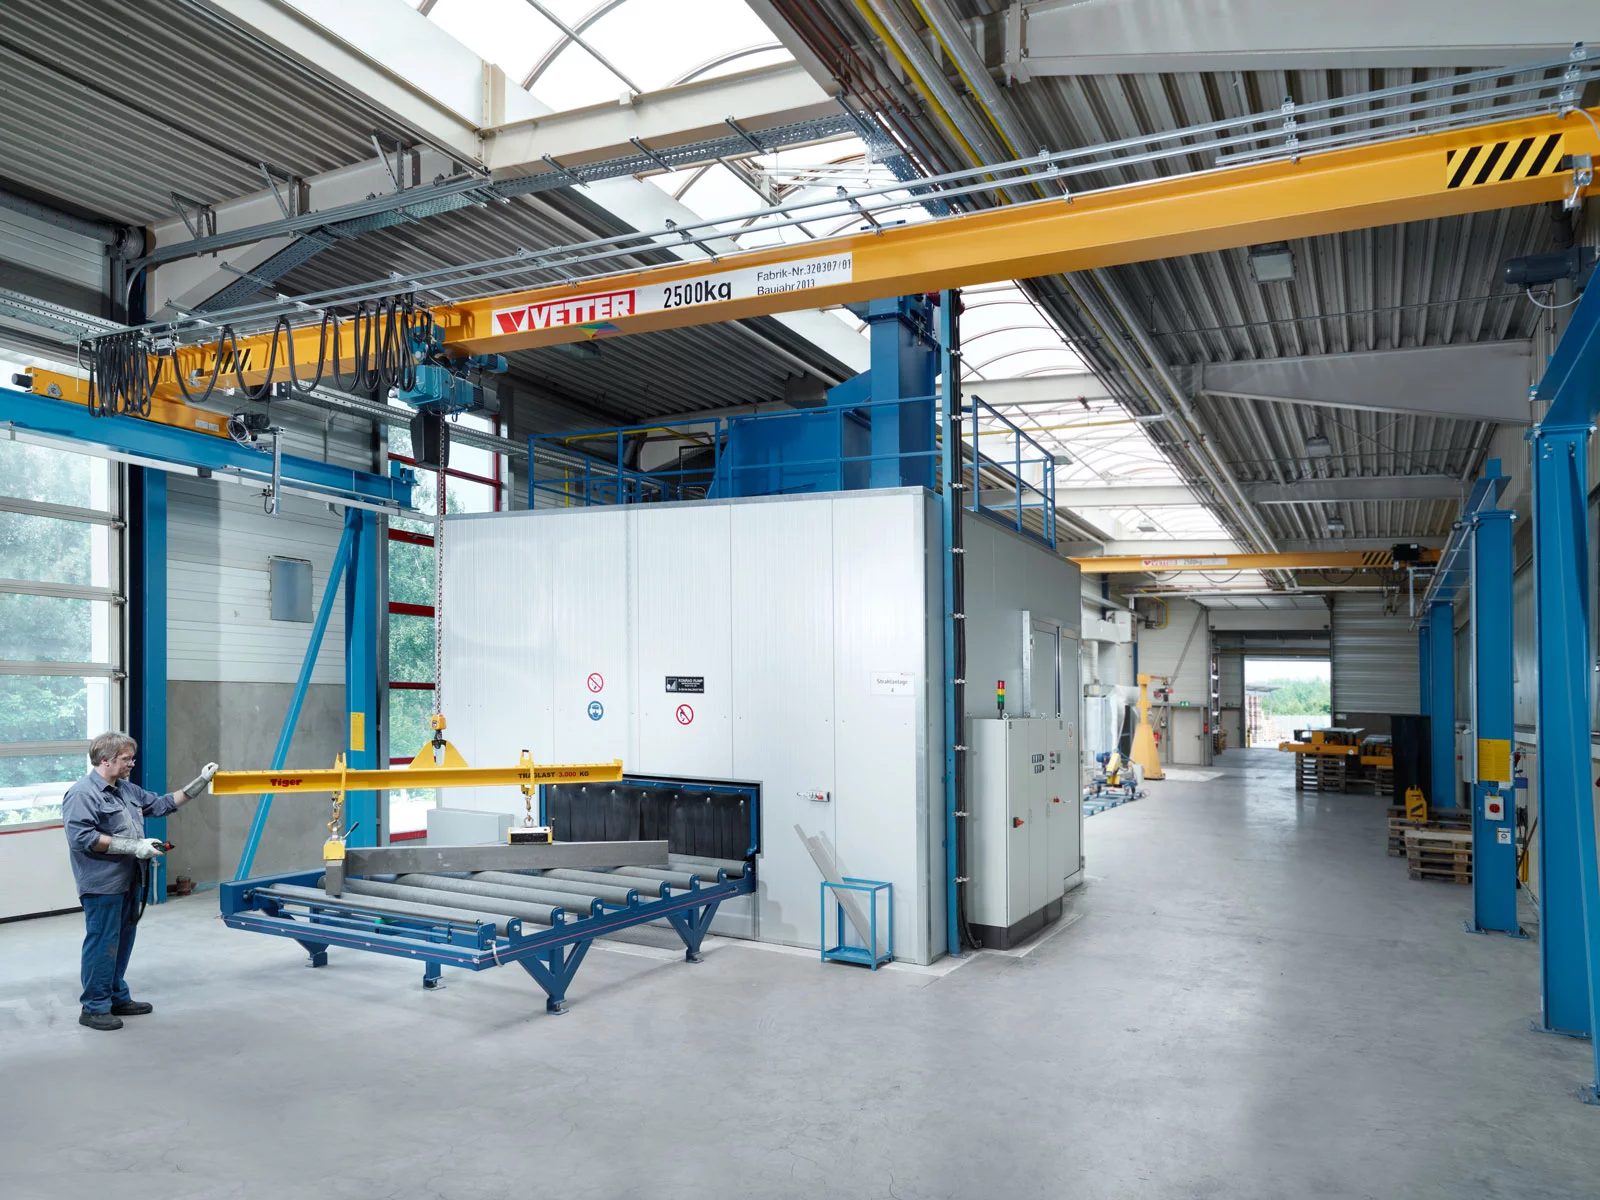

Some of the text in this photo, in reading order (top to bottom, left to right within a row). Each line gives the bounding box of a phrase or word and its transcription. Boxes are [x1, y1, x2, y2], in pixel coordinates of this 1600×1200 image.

[664, 280, 731, 308] 2500kg
[530, 293, 630, 330] VETTER
[270, 778, 303, 787] Tiger
